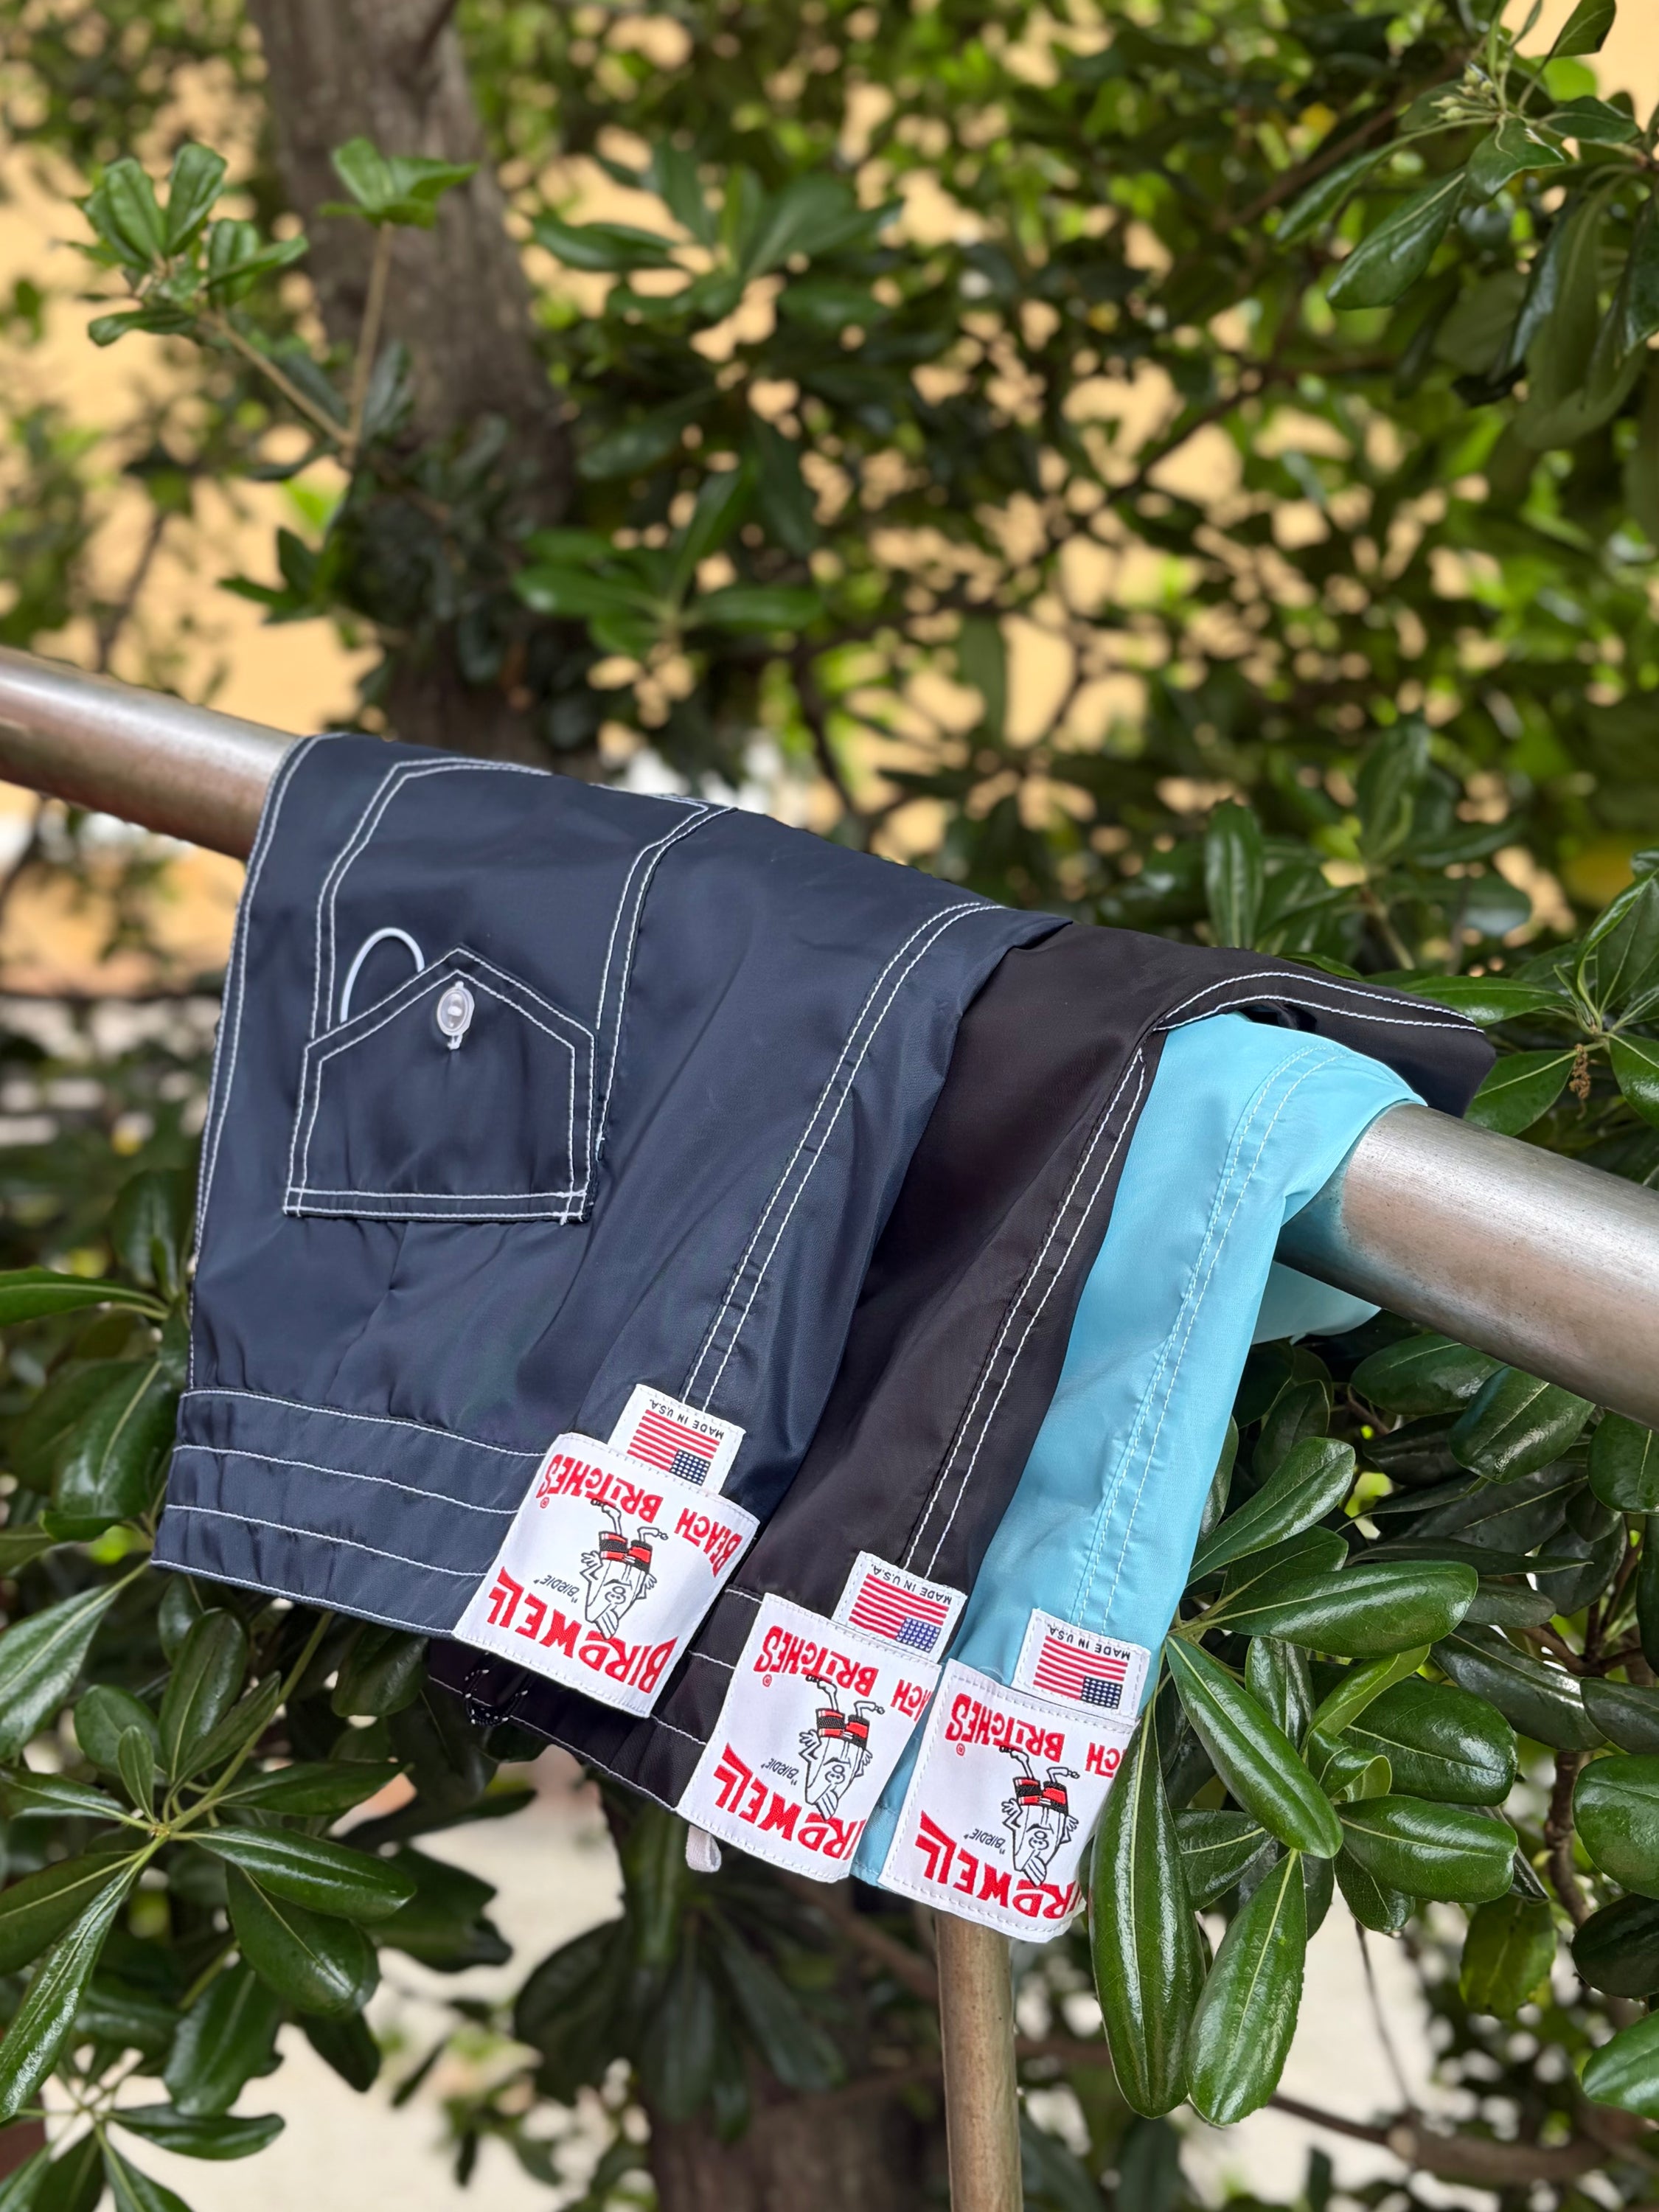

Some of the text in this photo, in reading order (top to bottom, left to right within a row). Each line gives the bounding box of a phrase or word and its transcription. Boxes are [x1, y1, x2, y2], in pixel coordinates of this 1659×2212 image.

[677, 1414, 689, 1424] IN
[694, 1420, 724, 1439] MADE
[674, 1508, 742, 1576] BEACH
[903, 1579, 916, 1591] IN
[919, 1587, 952, 1604] MADE
[487, 1568, 678, 1694] BIRDWELL
[1078, 1638, 1089, 1649] IN
[1094, 1644, 1130, 1660] MADE
[713, 1744, 866, 1860] IRDWELL
[914, 1811, 1082, 1919] IRDWELL
